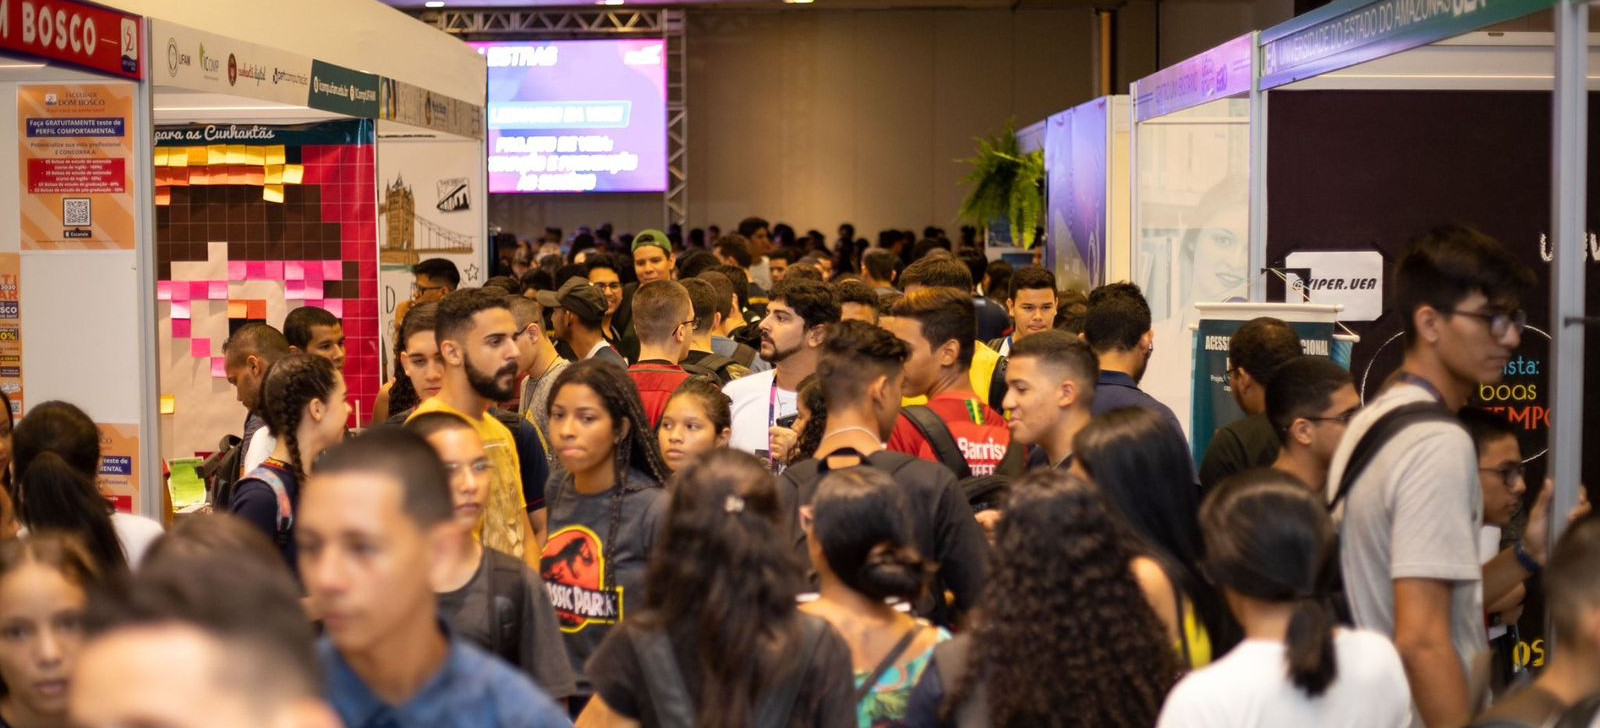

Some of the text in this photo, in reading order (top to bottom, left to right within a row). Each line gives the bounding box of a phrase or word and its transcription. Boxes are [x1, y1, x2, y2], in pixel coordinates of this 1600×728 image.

[22, 1, 96, 56] BOSCO
[1279, 26, 1330, 66] UNIVERSIDADE
[1330, 22, 1343, 49] DO
[1344, 9, 1378, 45] ESTADO
[1379, 3, 1393, 33] DO
[1394, 0, 1450, 29] AMAZONAS
[479, 46, 559, 67] ESTRAS
[153, 125, 275, 145] para as Cunhantãs
[1480, 384, 1537, 401] boas
